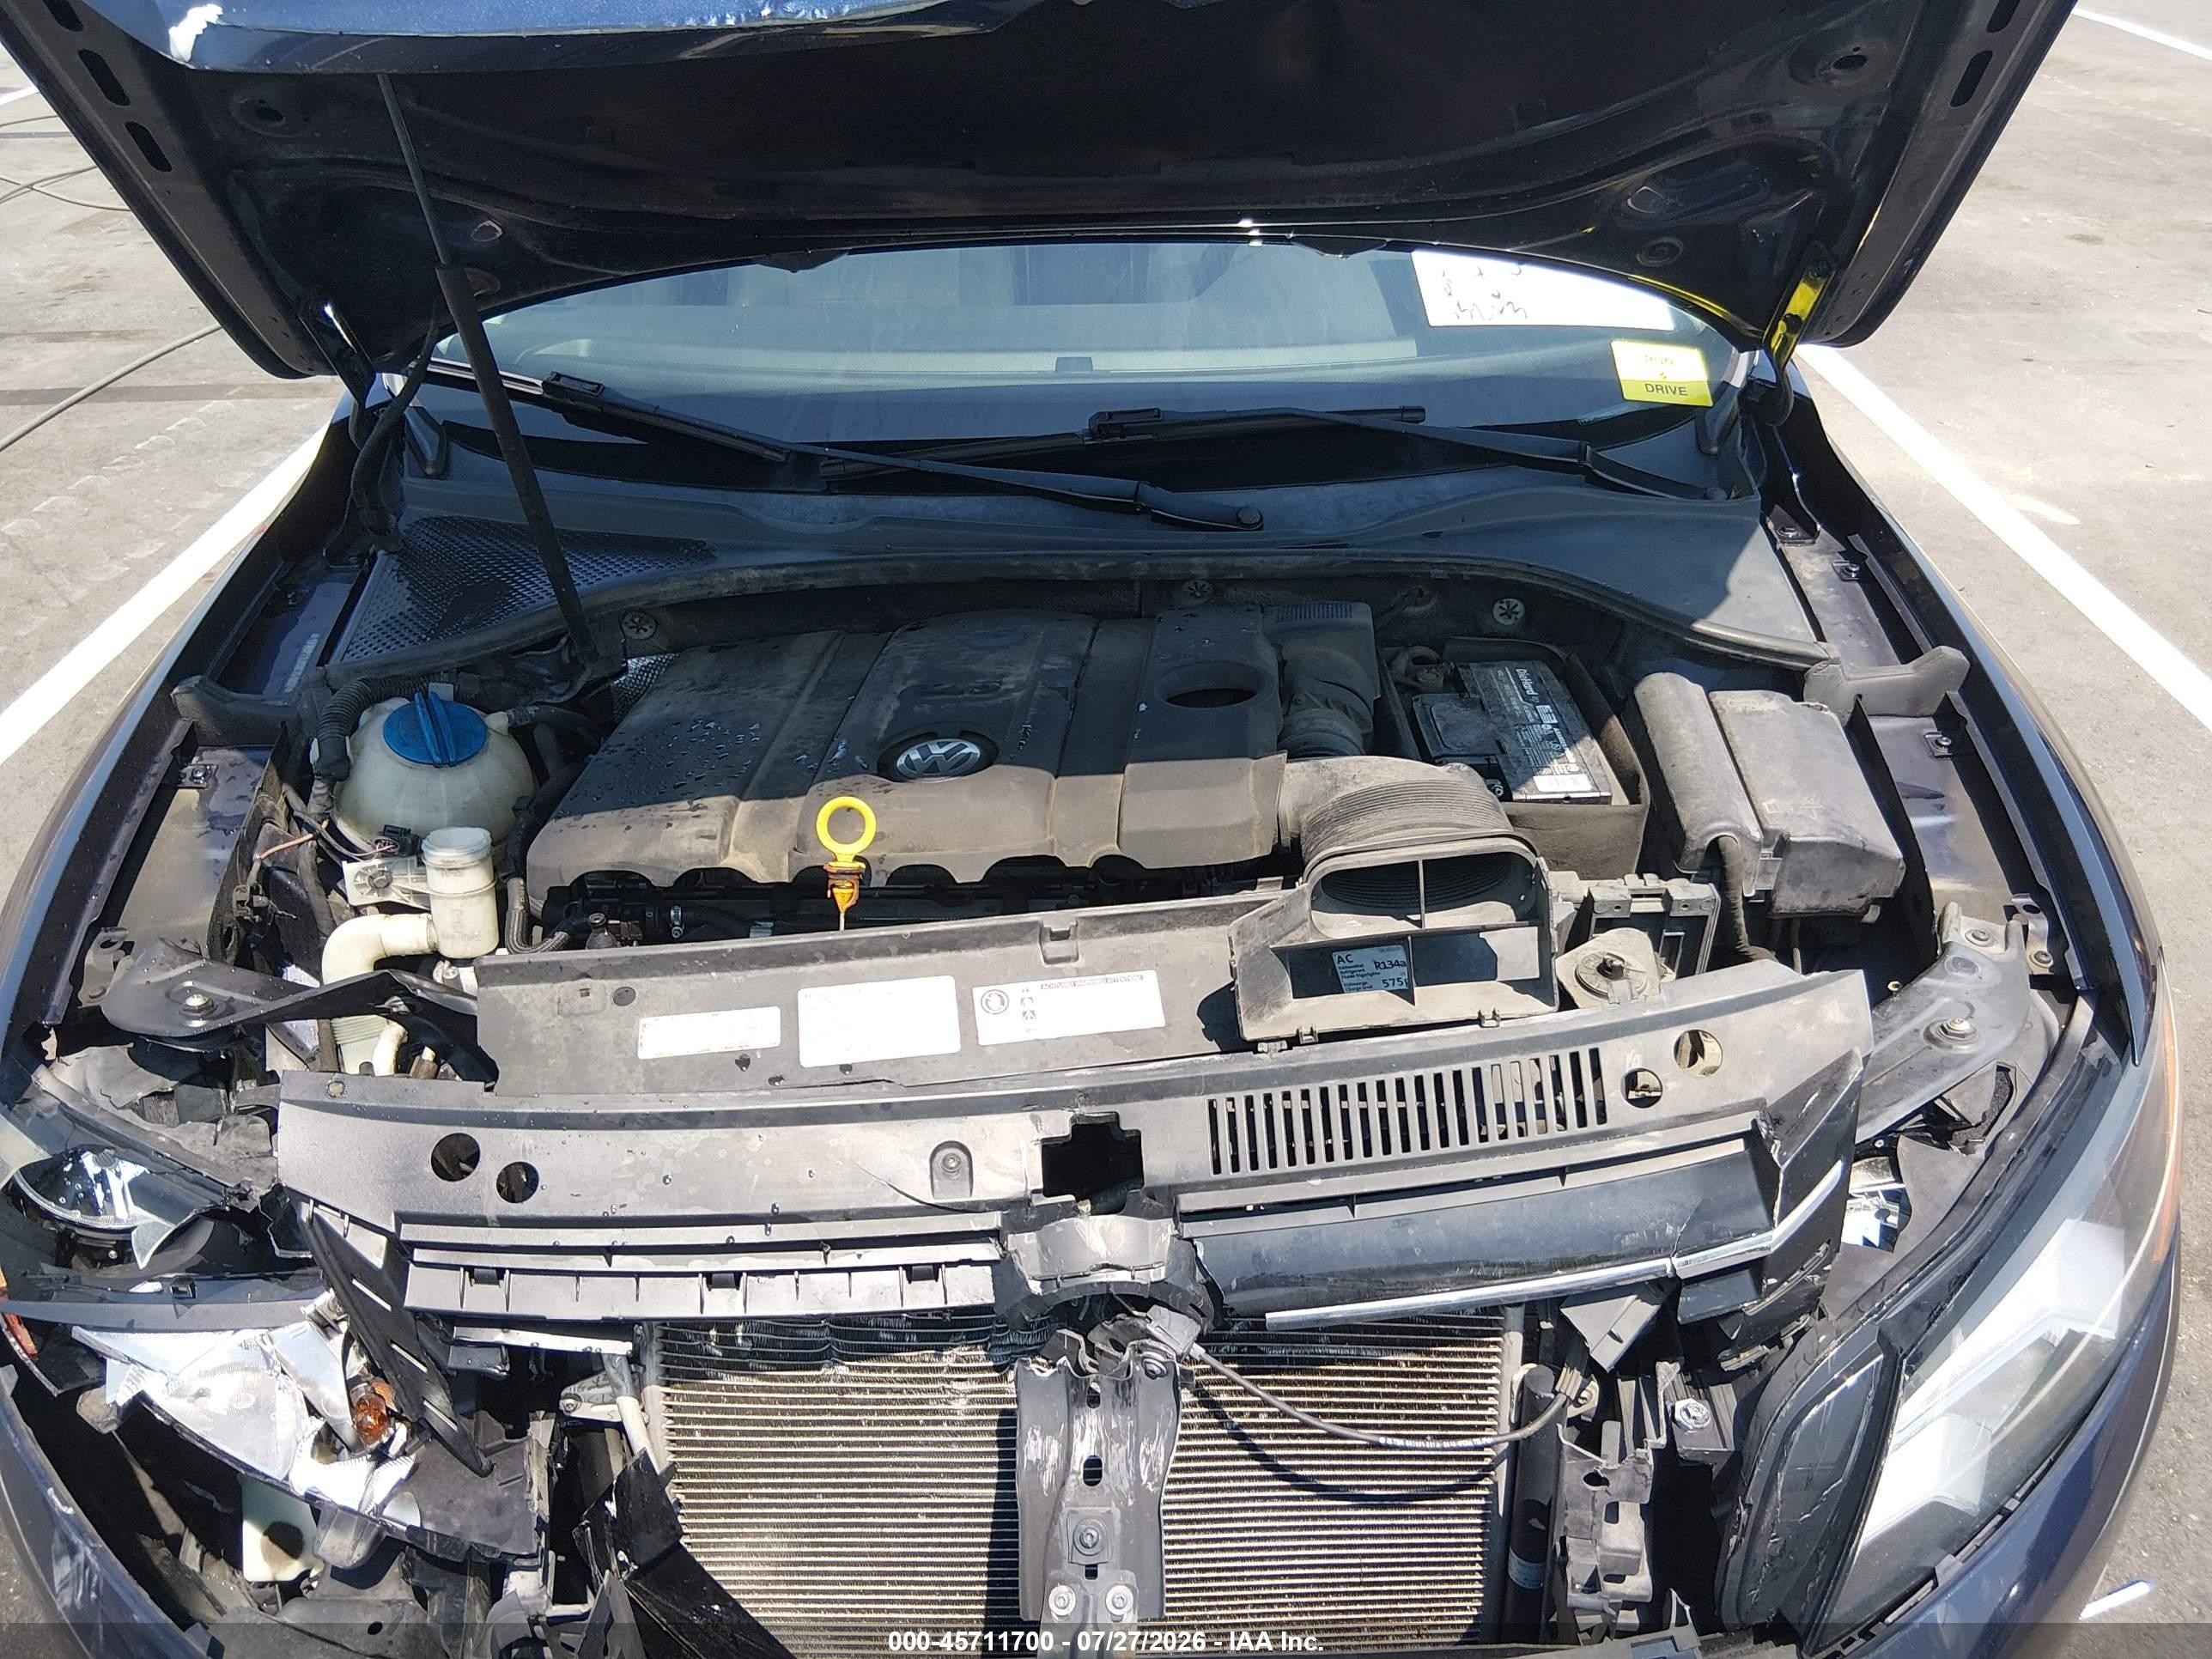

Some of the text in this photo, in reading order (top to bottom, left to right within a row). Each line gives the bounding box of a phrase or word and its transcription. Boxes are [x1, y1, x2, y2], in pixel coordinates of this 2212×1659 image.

[1644, 383, 1688, 396] DRIVE
[1516, 668, 1539, 696] DieHard
[896, 738, 981, 780] VW
[1337, 954, 1354, 964] AC
[1373, 959, 1407, 970] R134a
